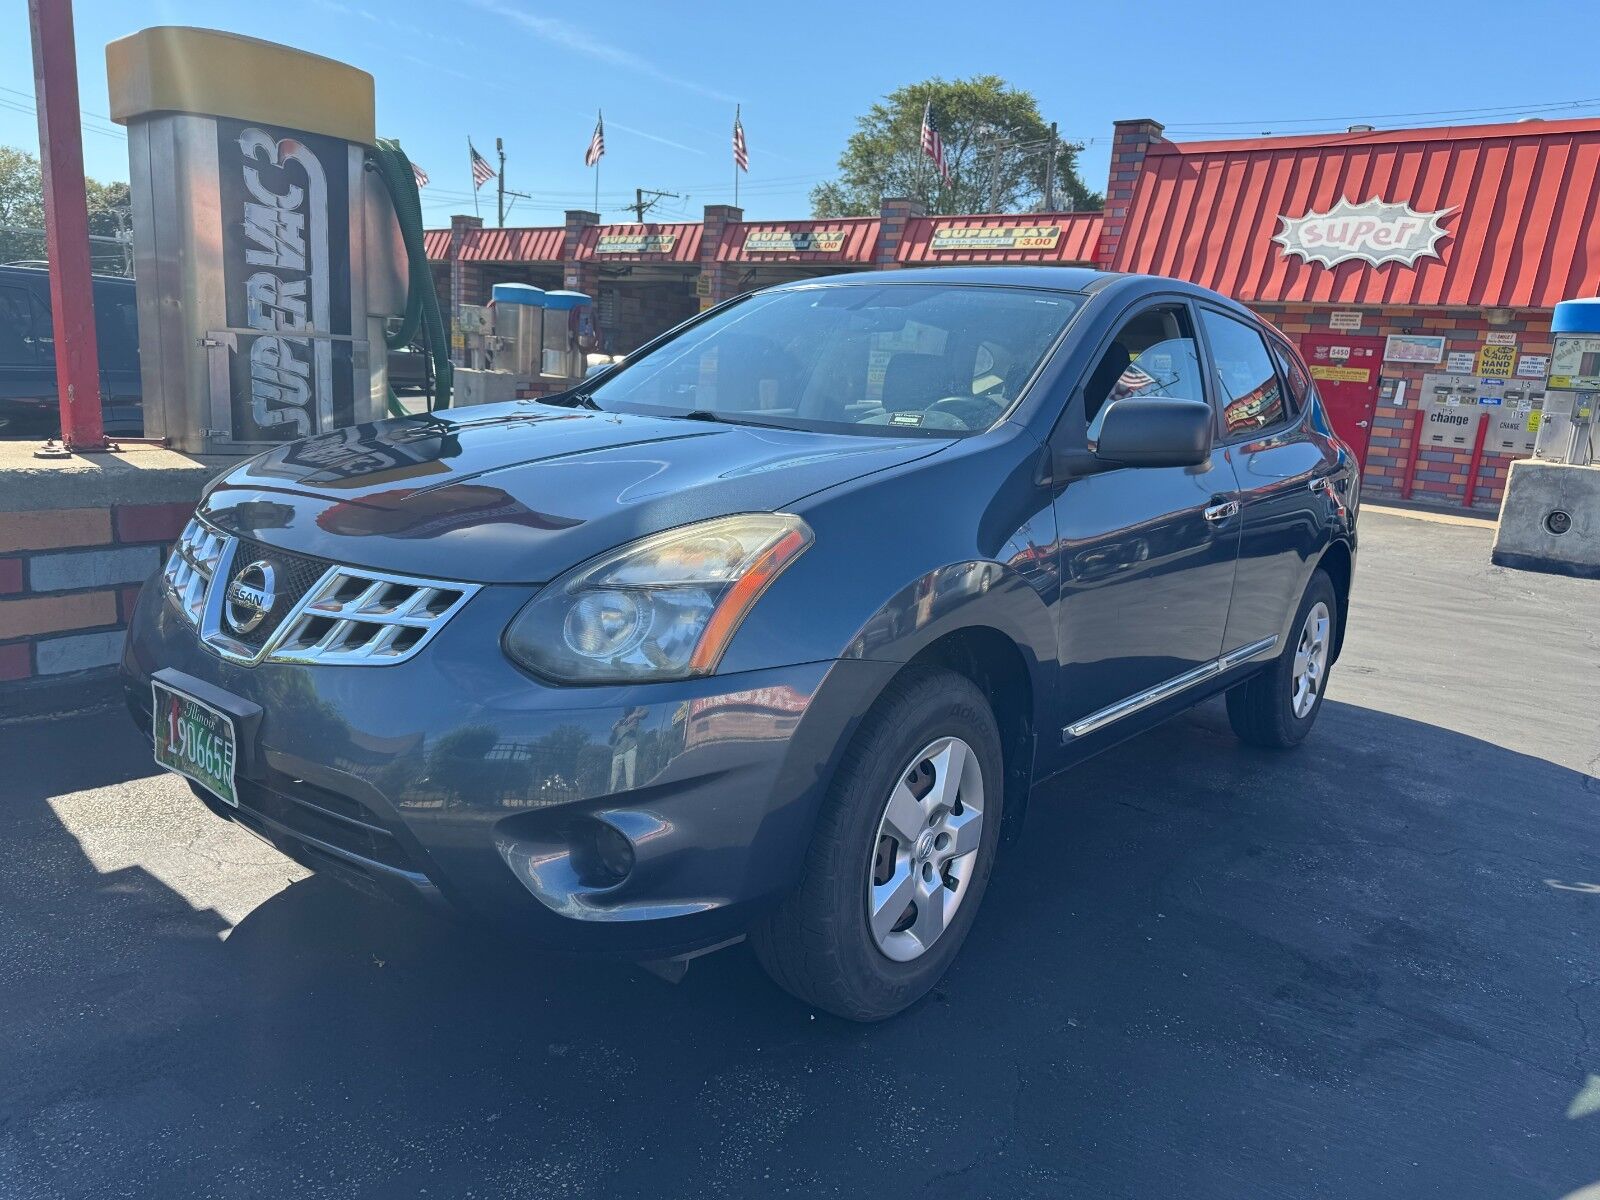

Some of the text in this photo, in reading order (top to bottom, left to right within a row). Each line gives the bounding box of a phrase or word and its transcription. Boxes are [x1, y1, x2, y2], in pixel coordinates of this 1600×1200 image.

[750, 232, 803, 241] SUPER
[938, 227, 1054, 238] SUPER BAY
[1331, 348, 1349, 357] 5450
[1490, 350, 1513, 361] Auto
[1482, 360, 1510, 368] HAND
[1481, 367, 1509, 375] WASH
[1430, 412, 1469, 426] change
[1500, 421, 1520, 430] CHANGE
[184, 701, 217, 731] Illinois
